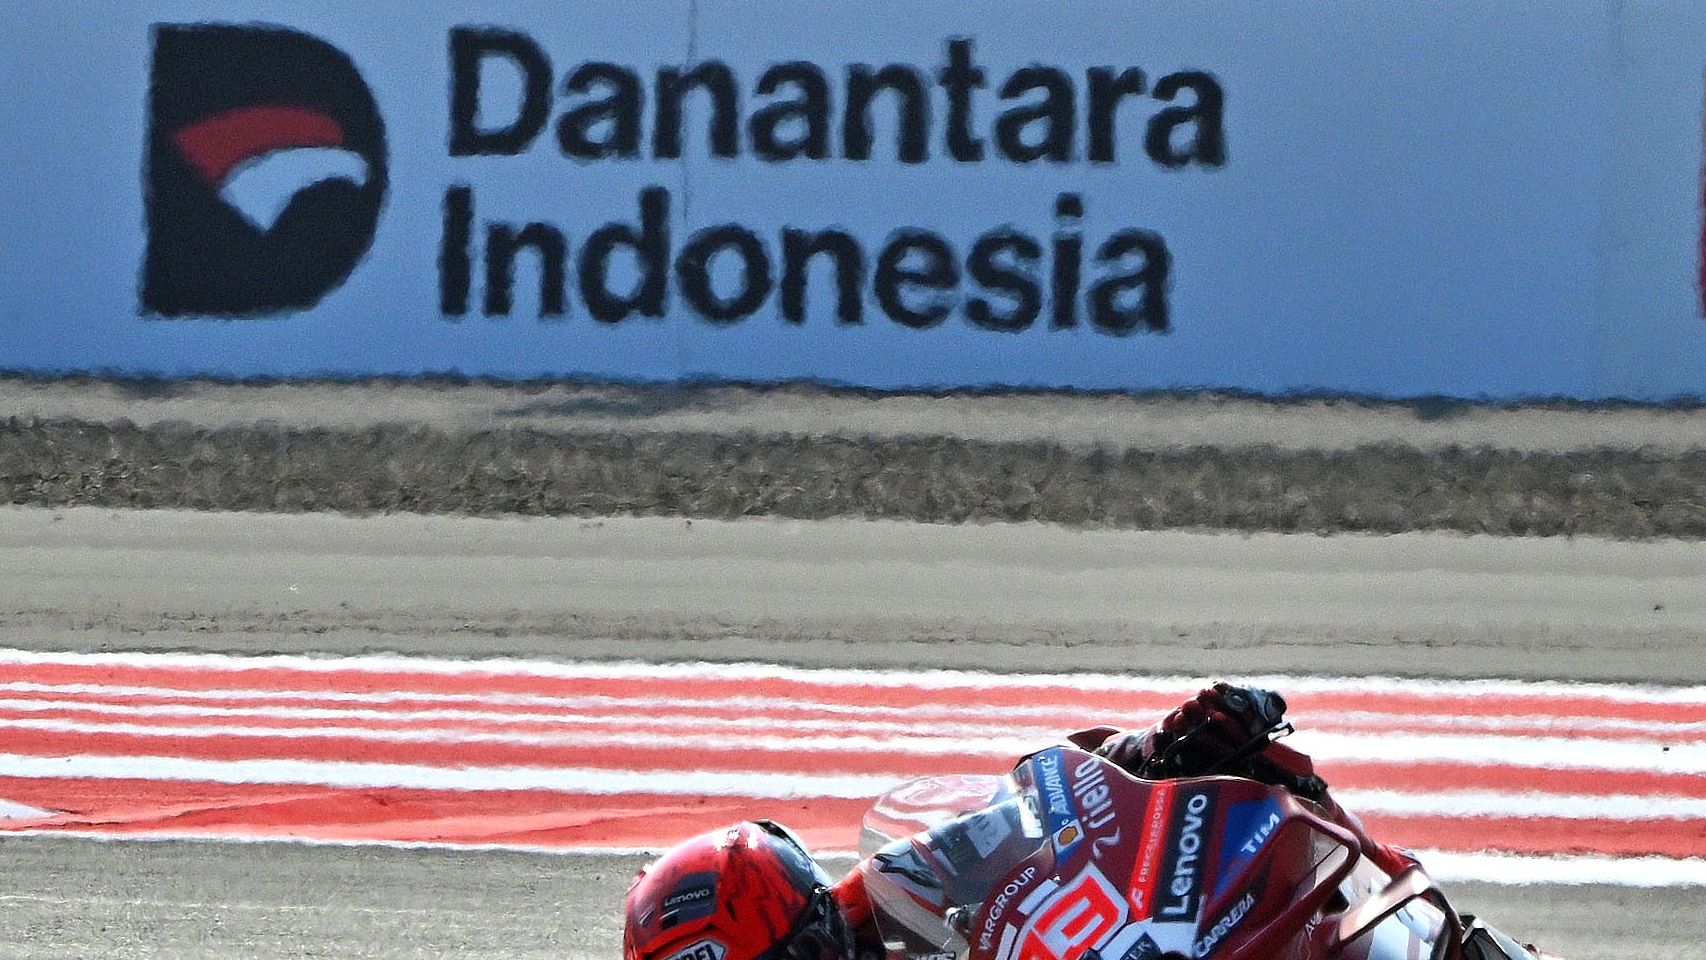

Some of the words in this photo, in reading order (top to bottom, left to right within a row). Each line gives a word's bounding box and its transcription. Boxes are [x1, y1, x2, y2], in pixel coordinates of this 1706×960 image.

[446, 25, 1226, 169] Danantara
[438, 186, 1171, 336] Indonesia
[1049, 755, 1069, 815] ADVANCE
[1074, 756, 1117, 830] riello
[1163, 792, 1208, 916] Lenovo
[1241, 811, 1281, 855] TIM
[979, 865, 1036, 951] VARGROUP
[1197, 892, 1255, 958] CARRERA
